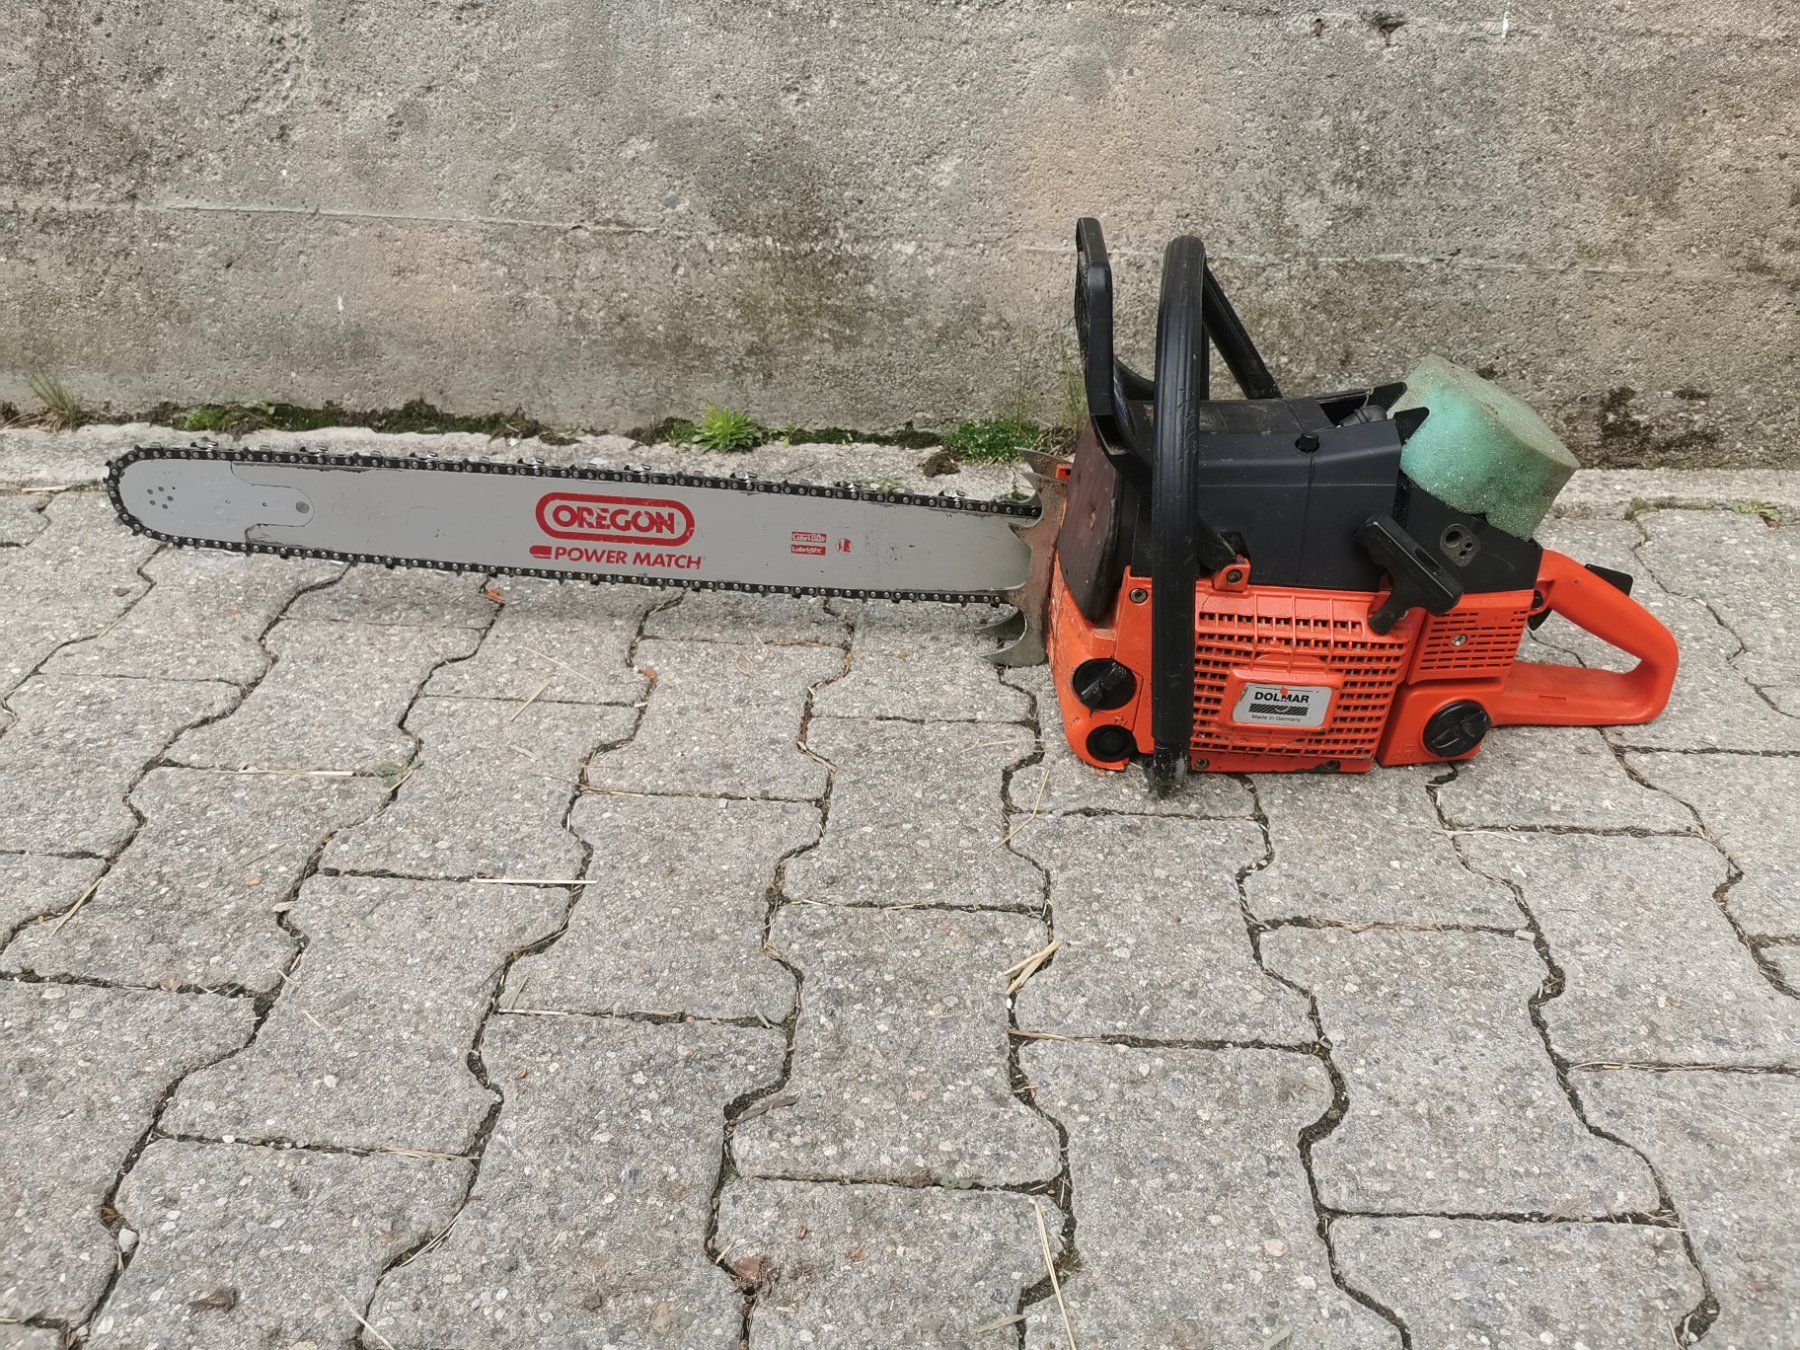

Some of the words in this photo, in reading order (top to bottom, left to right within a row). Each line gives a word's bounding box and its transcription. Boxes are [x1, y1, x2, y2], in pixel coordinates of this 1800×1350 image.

[552, 504, 675, 534] OREGON
[554, 546, 628, 564] POWER
[633, 551, 702, 570] MATCH
[1254, 691, 1310, 703] DOLMAR
[1275, 715, 1302, 723] Germany
